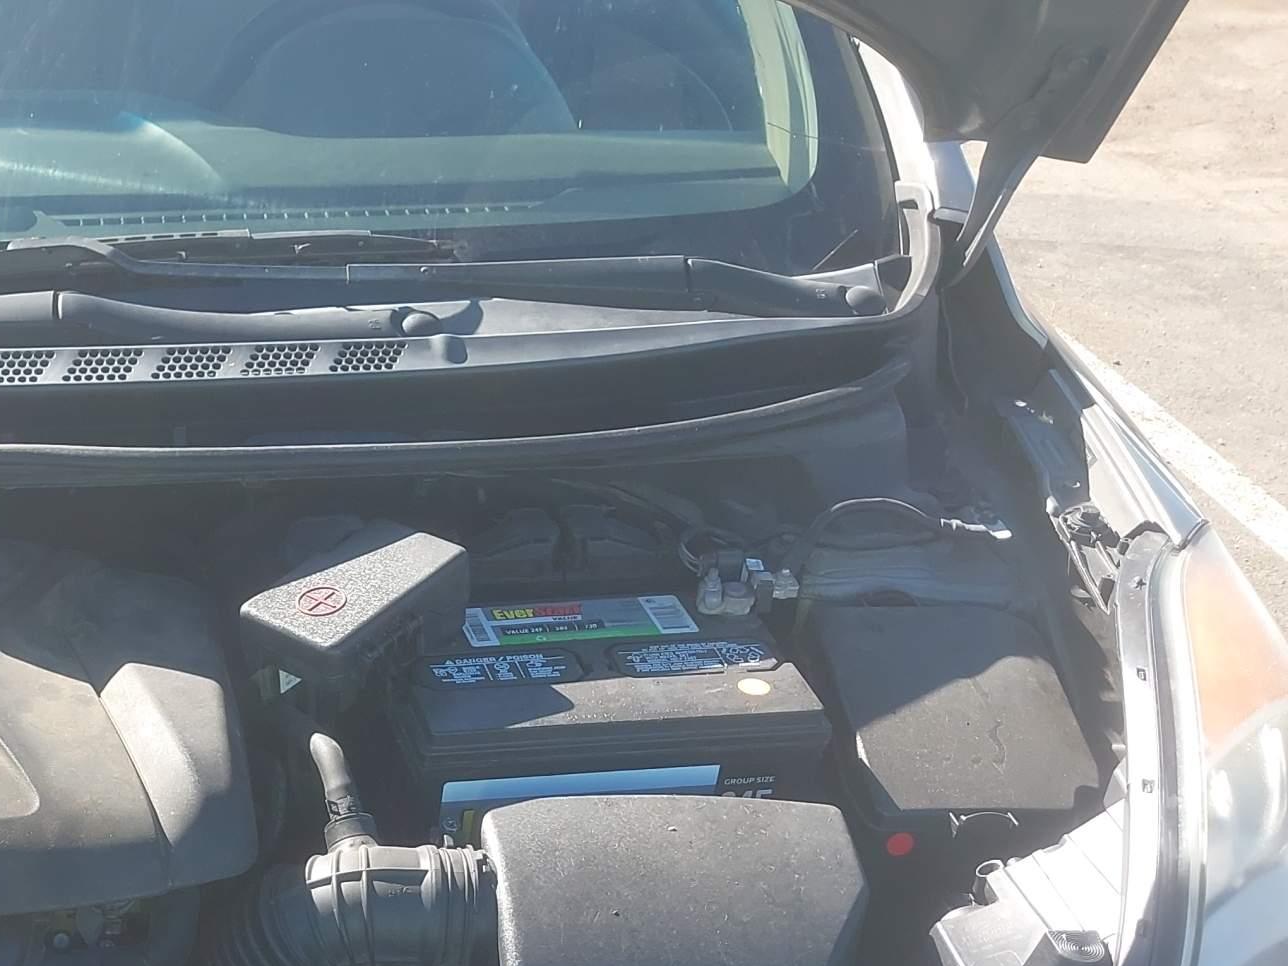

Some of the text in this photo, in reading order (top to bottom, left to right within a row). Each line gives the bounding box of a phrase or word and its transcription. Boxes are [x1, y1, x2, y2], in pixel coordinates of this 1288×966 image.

[455, 656, 496, 665] DANGER
[506, 653, 544, 661] POISON
[724, 775, 776, 785] GROUP SIZE
